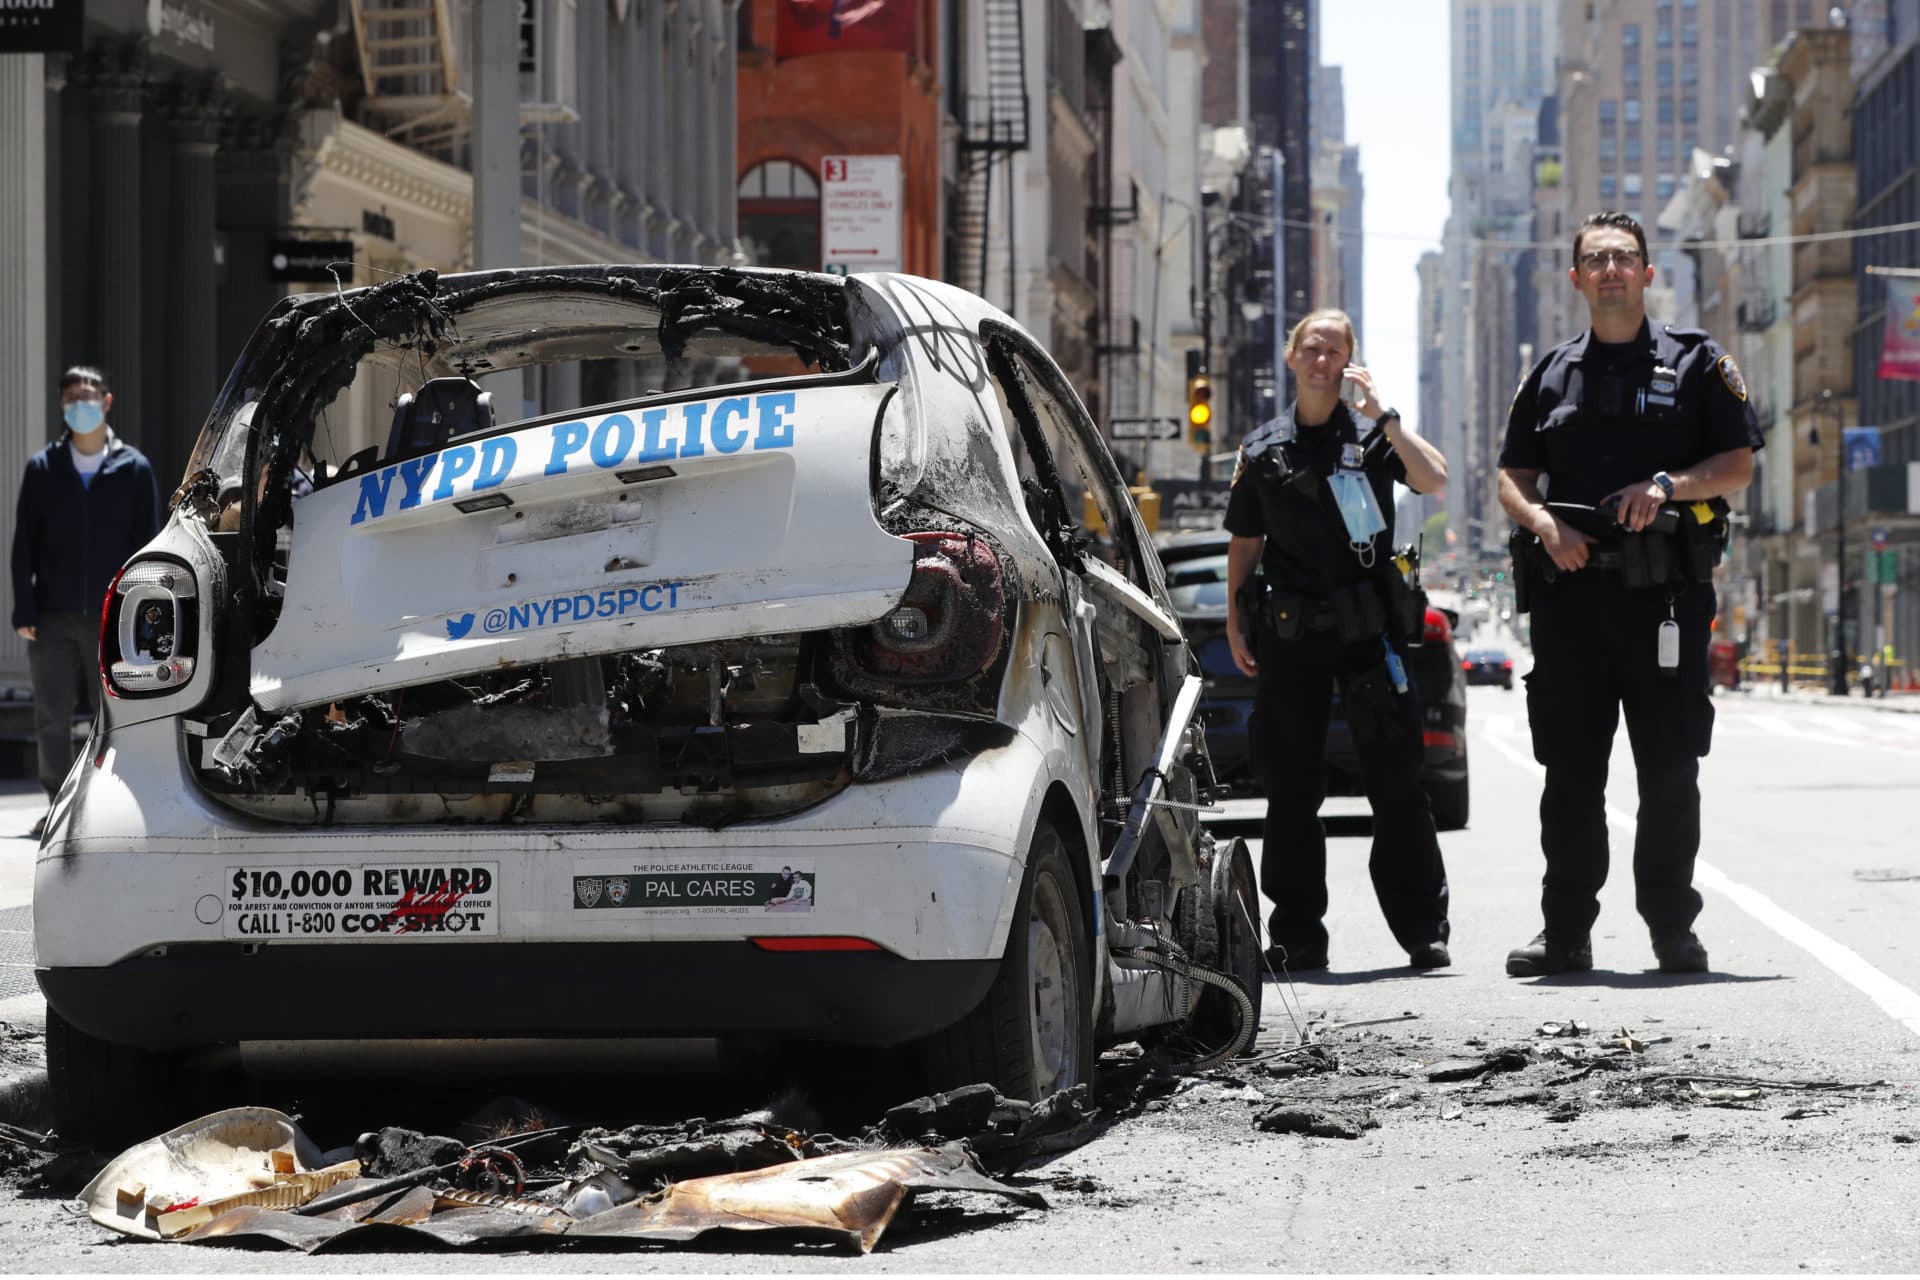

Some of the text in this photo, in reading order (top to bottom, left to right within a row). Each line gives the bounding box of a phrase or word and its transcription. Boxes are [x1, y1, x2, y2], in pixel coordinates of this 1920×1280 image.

[830, 160, 843, 181] 3
[350, 392, 796, 525] NYPD POLICE
[483, 582, 684, 633] @NYPD5PCT
[650, 864, 680, 872] POLICE
[681, 864, 719, 872] ATHLETIC
[720, 863, 753, 871] LEAGUE
[232, 868, 492, 900] $10,000 REWARD
[645, 881, 681, 897] PAL
[687, 880, 756, 897] CARES
[229, 904, 242, 912] FOR
[244, 903, 270, 911] ARREST
[272, 903, 287, 911] AND
[289, 902, 332, 911] CONVICTION
[334, 902, 342, 910] OF
[345, 901, 373, 910] ANYONE
[376, 901, 412, 910] SHOO
[464, 900, 492, 909] OFFICER
[238, 911, 485, 934] CALL 1-800 COP-SHOT
